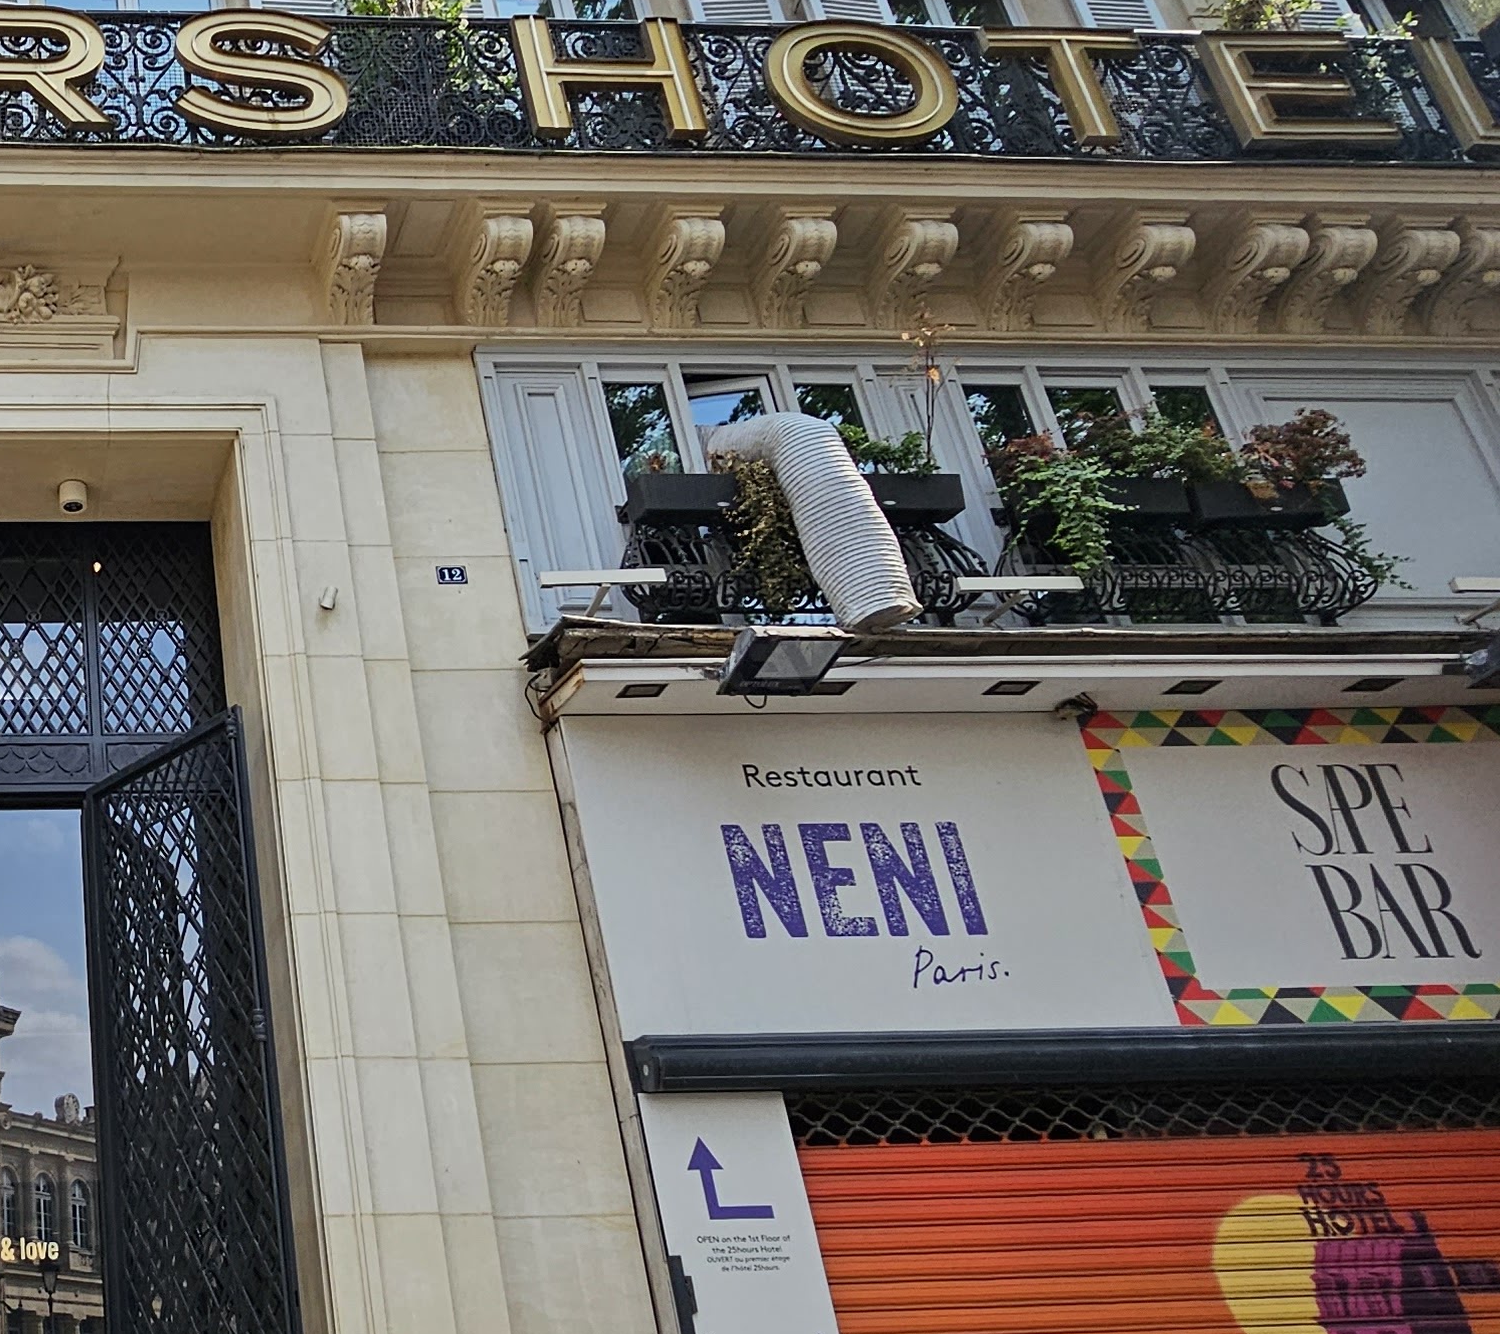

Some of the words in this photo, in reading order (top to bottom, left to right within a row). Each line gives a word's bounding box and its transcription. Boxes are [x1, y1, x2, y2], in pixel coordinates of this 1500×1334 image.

[441, 568, 463, 581] 12
[741, 763, 922, 789] Restaurant
[720, 821, 989, 938] NENI
[1304, 863, 1483, 960] BAR
[913, 945, 1011, 989] Paris.
[1298, 1152, 1342, 1179] 25
[1298, 1182, 1386, 1205] HOURS
[1303, 1207, 1405, 1237] HOTEL
[0, 1237, 15, 1261] &
[20, 1237, 59, 1261] love
[696, 1235, 719, 1244] OPEN
[733, 1235, 747, 1243] the
[782, 1234, 791, 1242] of
[711, 1246, 726, 1254] the
[727, 1246, 759, 1254] 25hours
[761, 1245, 782, 1253] Hotel
